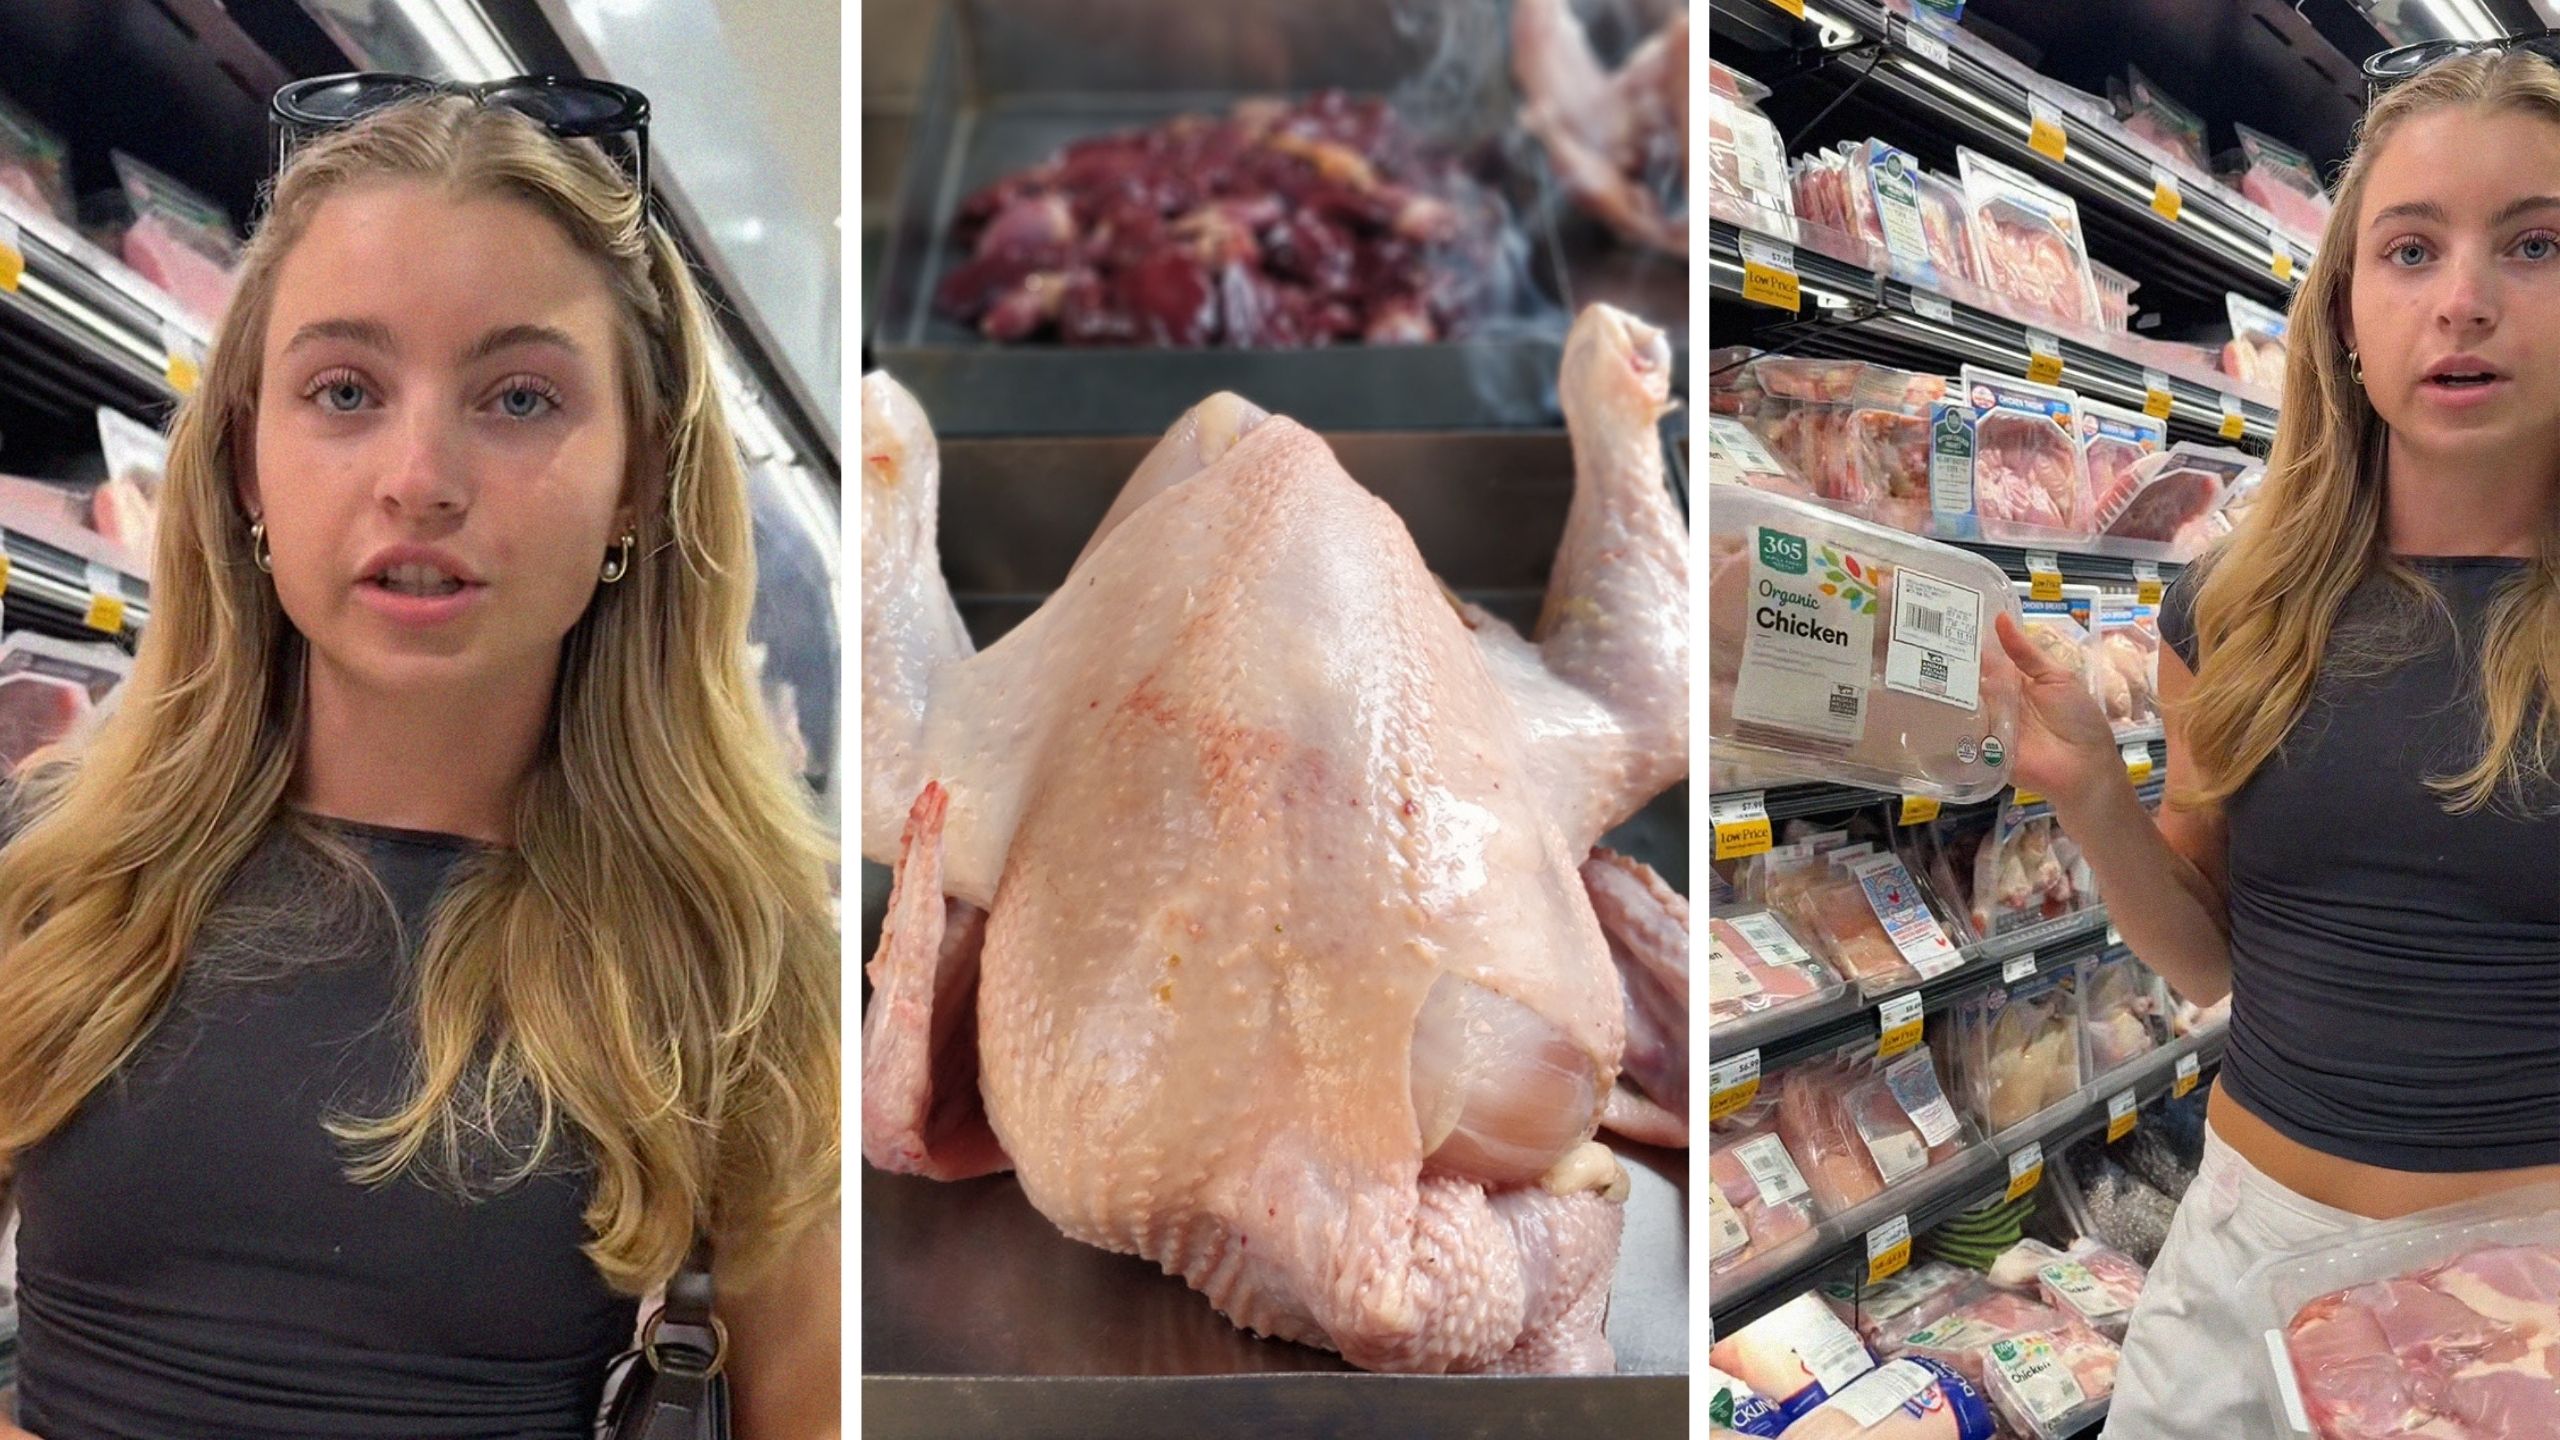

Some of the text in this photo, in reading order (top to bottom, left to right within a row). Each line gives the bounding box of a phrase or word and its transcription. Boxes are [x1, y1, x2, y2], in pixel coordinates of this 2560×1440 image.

[1750, 271, 1768, 284] Low
[1771, 276, 1798, 294] Price
[1764, 536, 1802, 560] 365
[1759, 579, 1820, 610] Organic
[1756, 607, 1848, 647] Chicken
[1742, 801, 1763, 812] $7.99
[1721, 829, 1769, 844] Low Price
